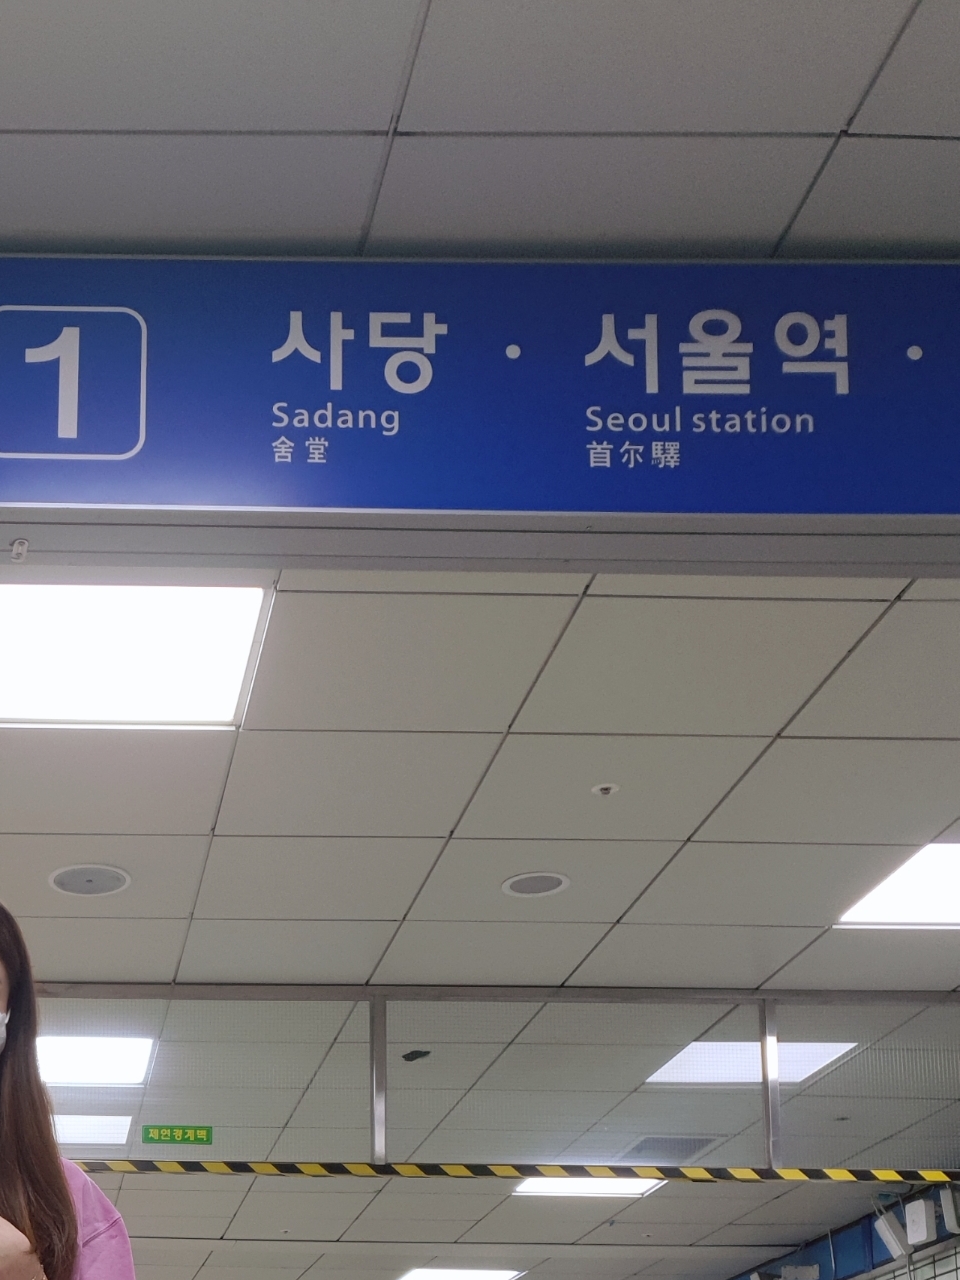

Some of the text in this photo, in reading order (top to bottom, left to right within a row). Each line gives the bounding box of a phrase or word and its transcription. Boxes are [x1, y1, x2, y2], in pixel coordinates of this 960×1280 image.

[271, 308, 850, 395] 사당 서울역
[24, 325, 80, 439] 1
[271, 402, 815, 436] Sadang Seoul station
[271, 435, 329, 464] 舍堂
[148, 1128, 207, 1141] 제연경계벽
